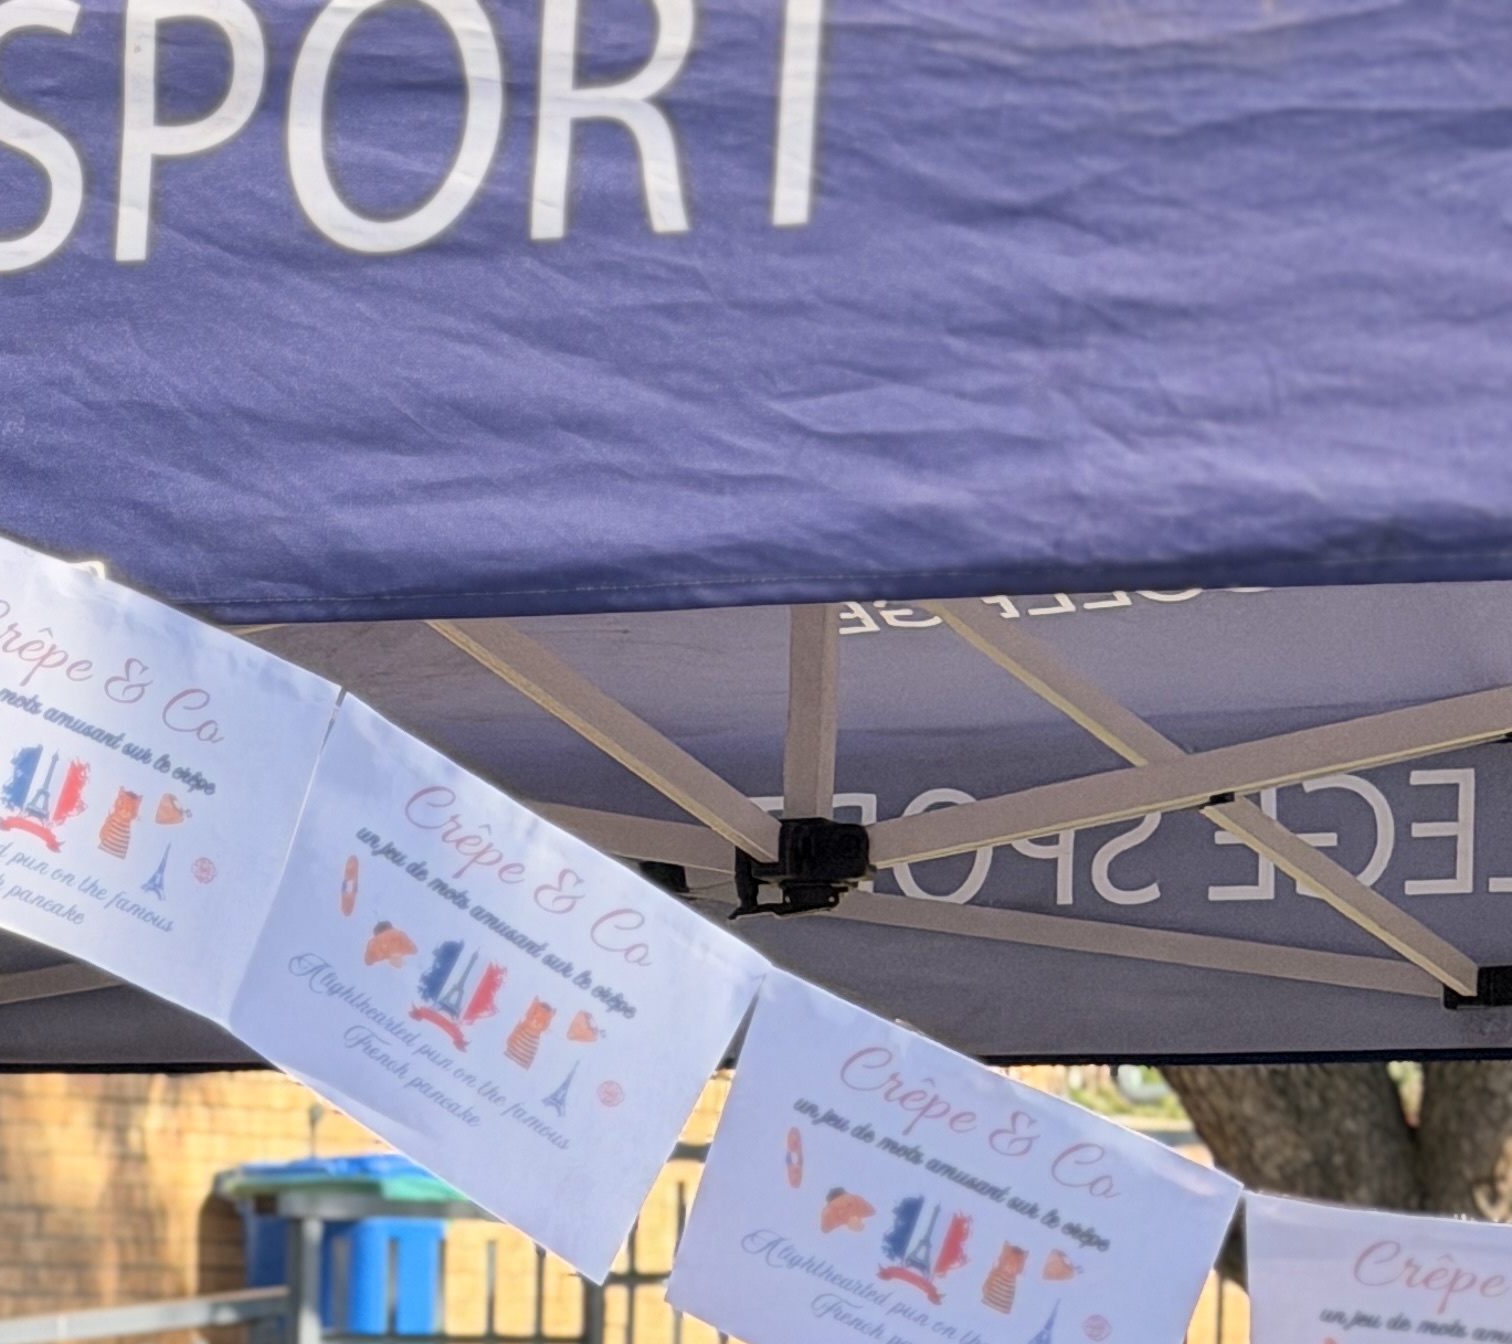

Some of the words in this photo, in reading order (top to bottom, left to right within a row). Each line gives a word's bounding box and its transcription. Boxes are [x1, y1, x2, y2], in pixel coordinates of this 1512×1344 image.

[104, 658, 154, 703] &
[162, 688, 224, 744] Co
[4, 882, 86, 926] pancake
[77, 875, 108, 901] the
[103, 890, 174, 933] famous
[405, 786, 526, 884] Crêpe
[534, 868, 585, 914] &
[591, 908, 653, 966] Co
[840, 1047, 977, 1136] Crêpe
[989, 1110, 1040, 1157] &
[1051, 1143, 1121, 1199] Co
